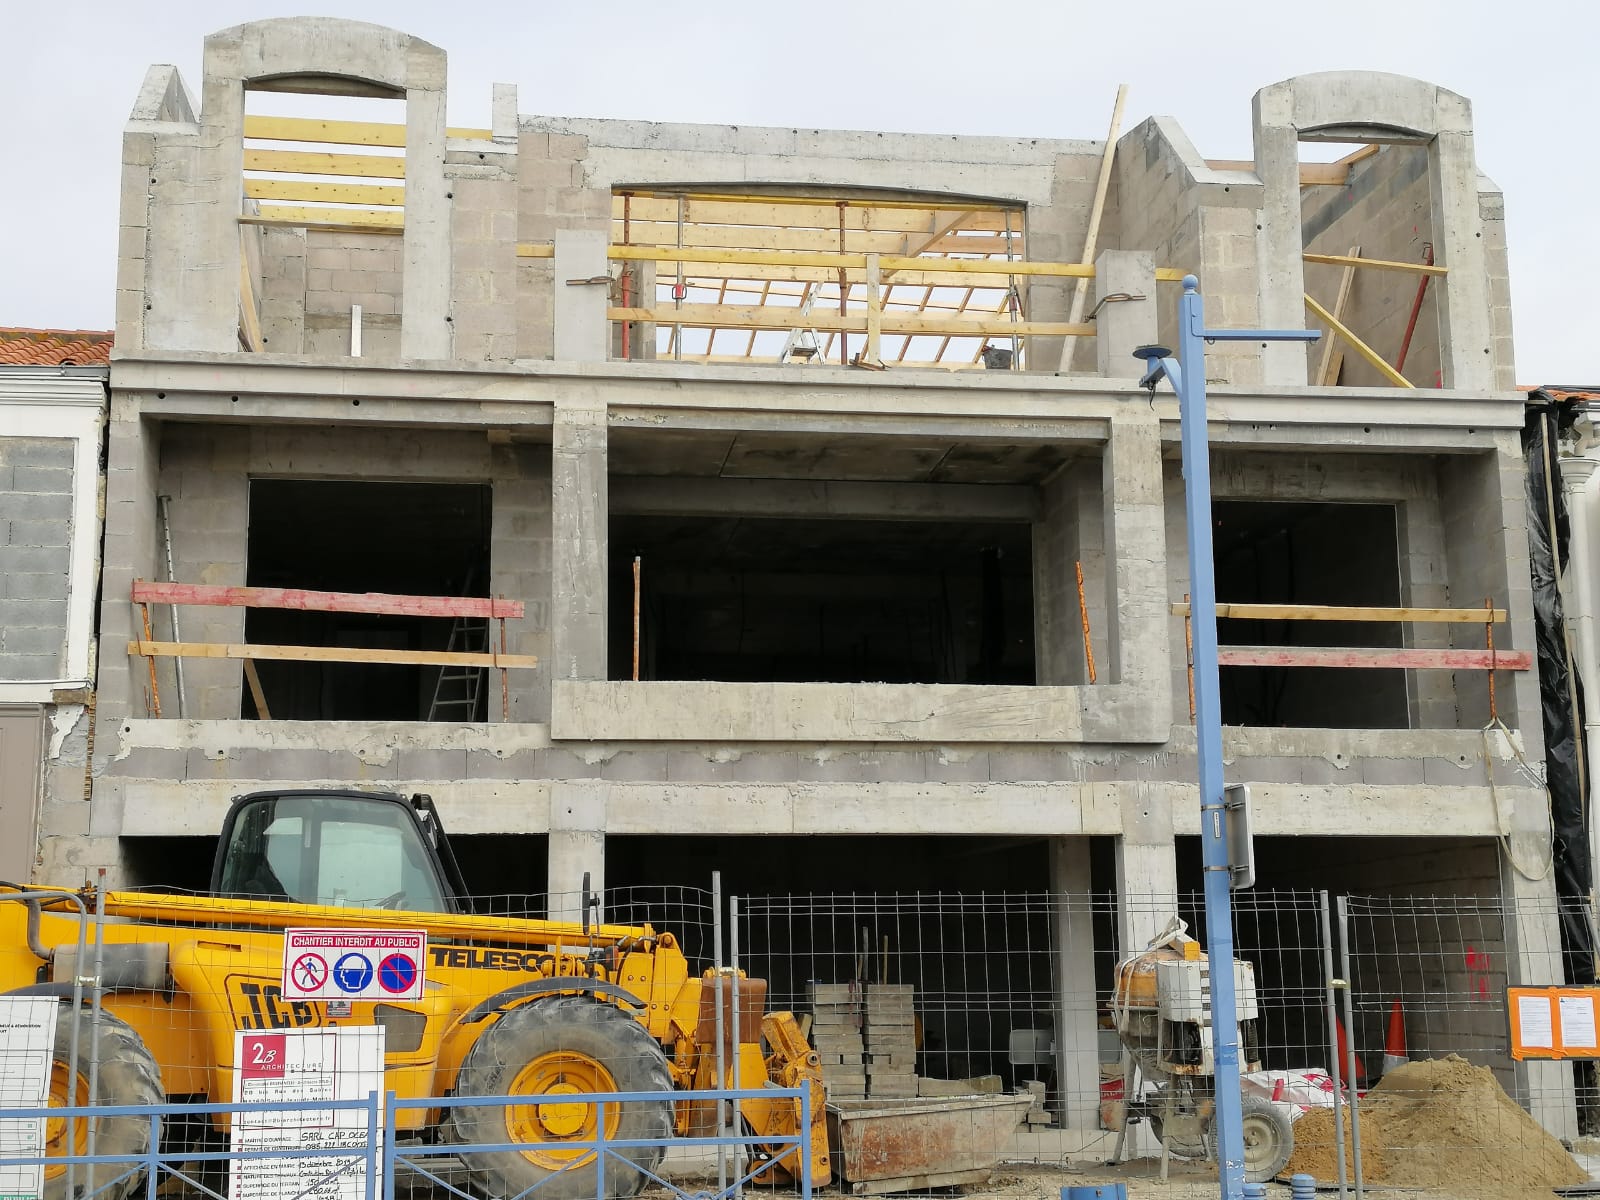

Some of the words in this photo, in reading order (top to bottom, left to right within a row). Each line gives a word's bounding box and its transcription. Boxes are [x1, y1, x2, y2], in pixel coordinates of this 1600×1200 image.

[293, 936, 333, 946] CHANTIER
[335, 937, 373, 947] INTERDIT
[375, 937, 386, 946] AU
[388, 937, 418, 947] PUBLIC
[240, 982, 314, 1029] JCB
[252, 1042, 277, 1064] 2B
[302, 1131, 324, 1141] SARL
[328, 1131, 346, 1140] CAP
[349, 1131, 368, 1139] OCEA
